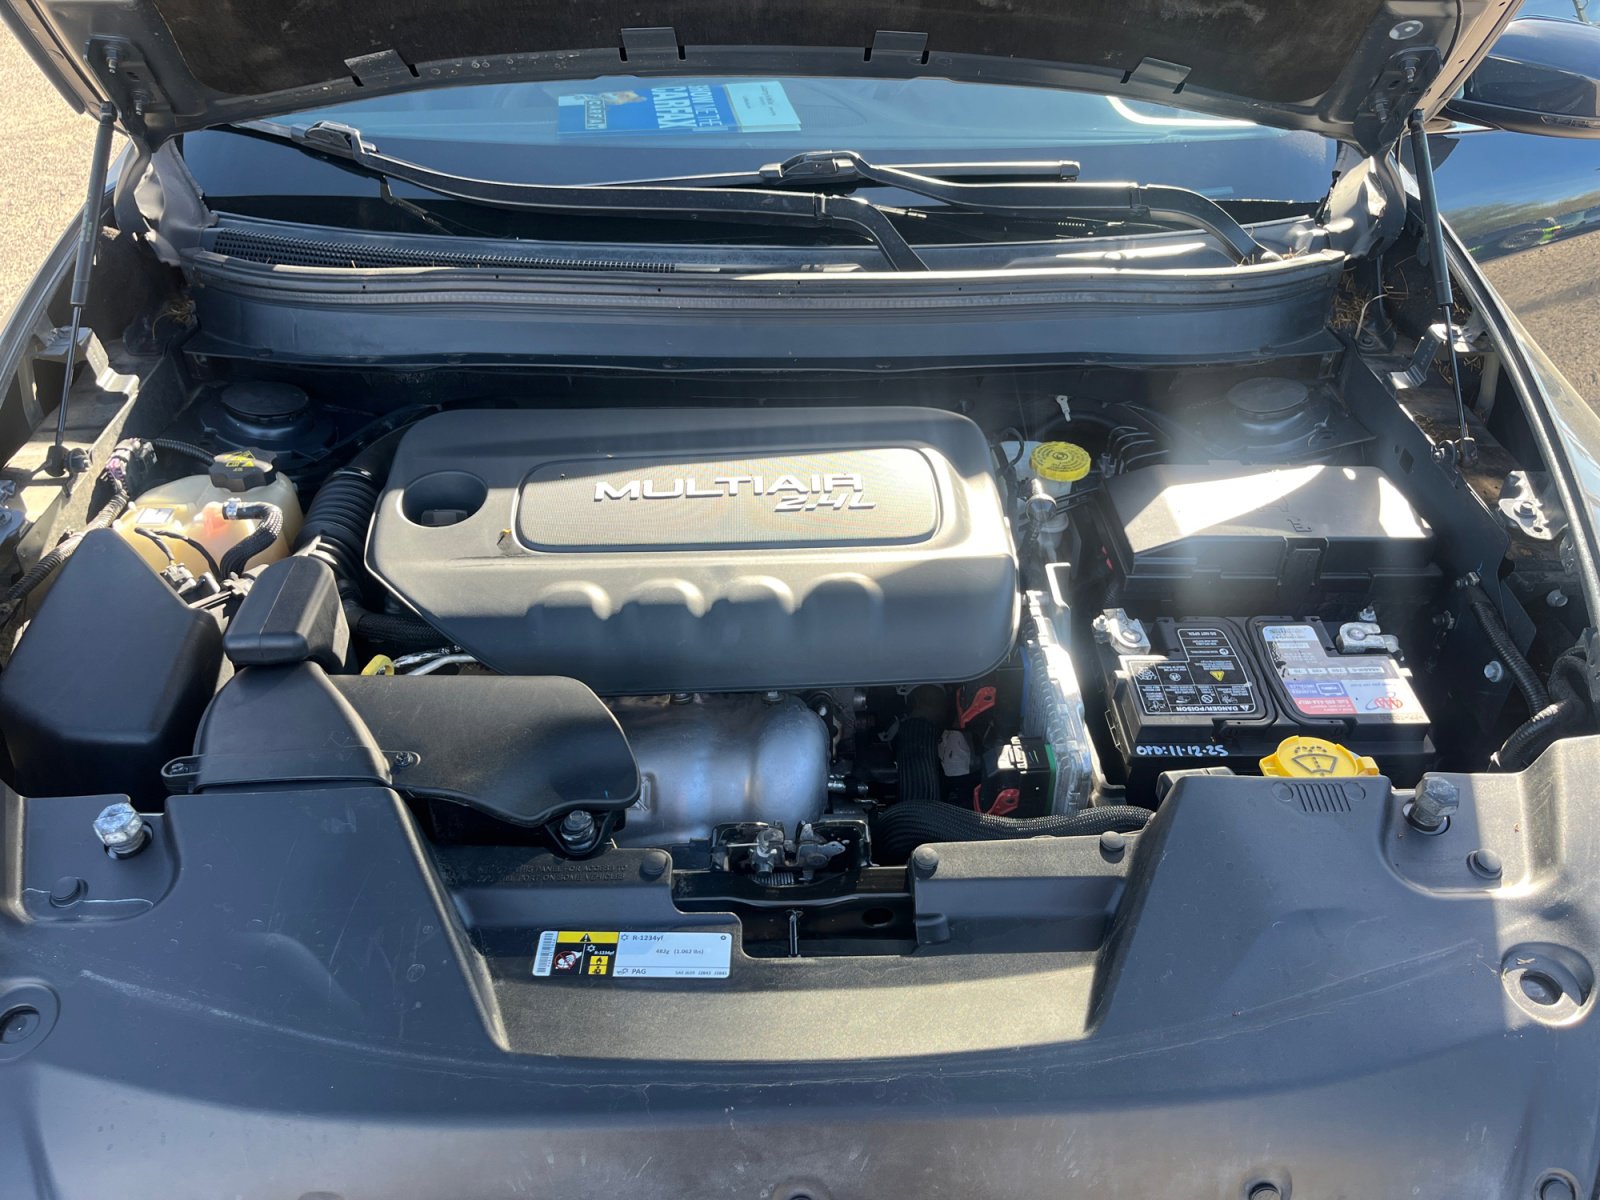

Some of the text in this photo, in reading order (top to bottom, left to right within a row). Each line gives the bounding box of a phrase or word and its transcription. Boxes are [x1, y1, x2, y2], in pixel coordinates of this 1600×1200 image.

[651, 86, 698, 129] CARFAX
[688, 85, 723, 127] SHOW ME THE
[593, 472, 864, 502] MULTIAIR
[774, 493, 876, 512] 2.4L
[1374, 696, 1404, 710] AAA
[543, 873, 555, 881] ON
[558, 873, 581, 881] SOME
[584, 873, 625, 881] VEHICLES
[632, 934, 664, 942] R-1234yf
